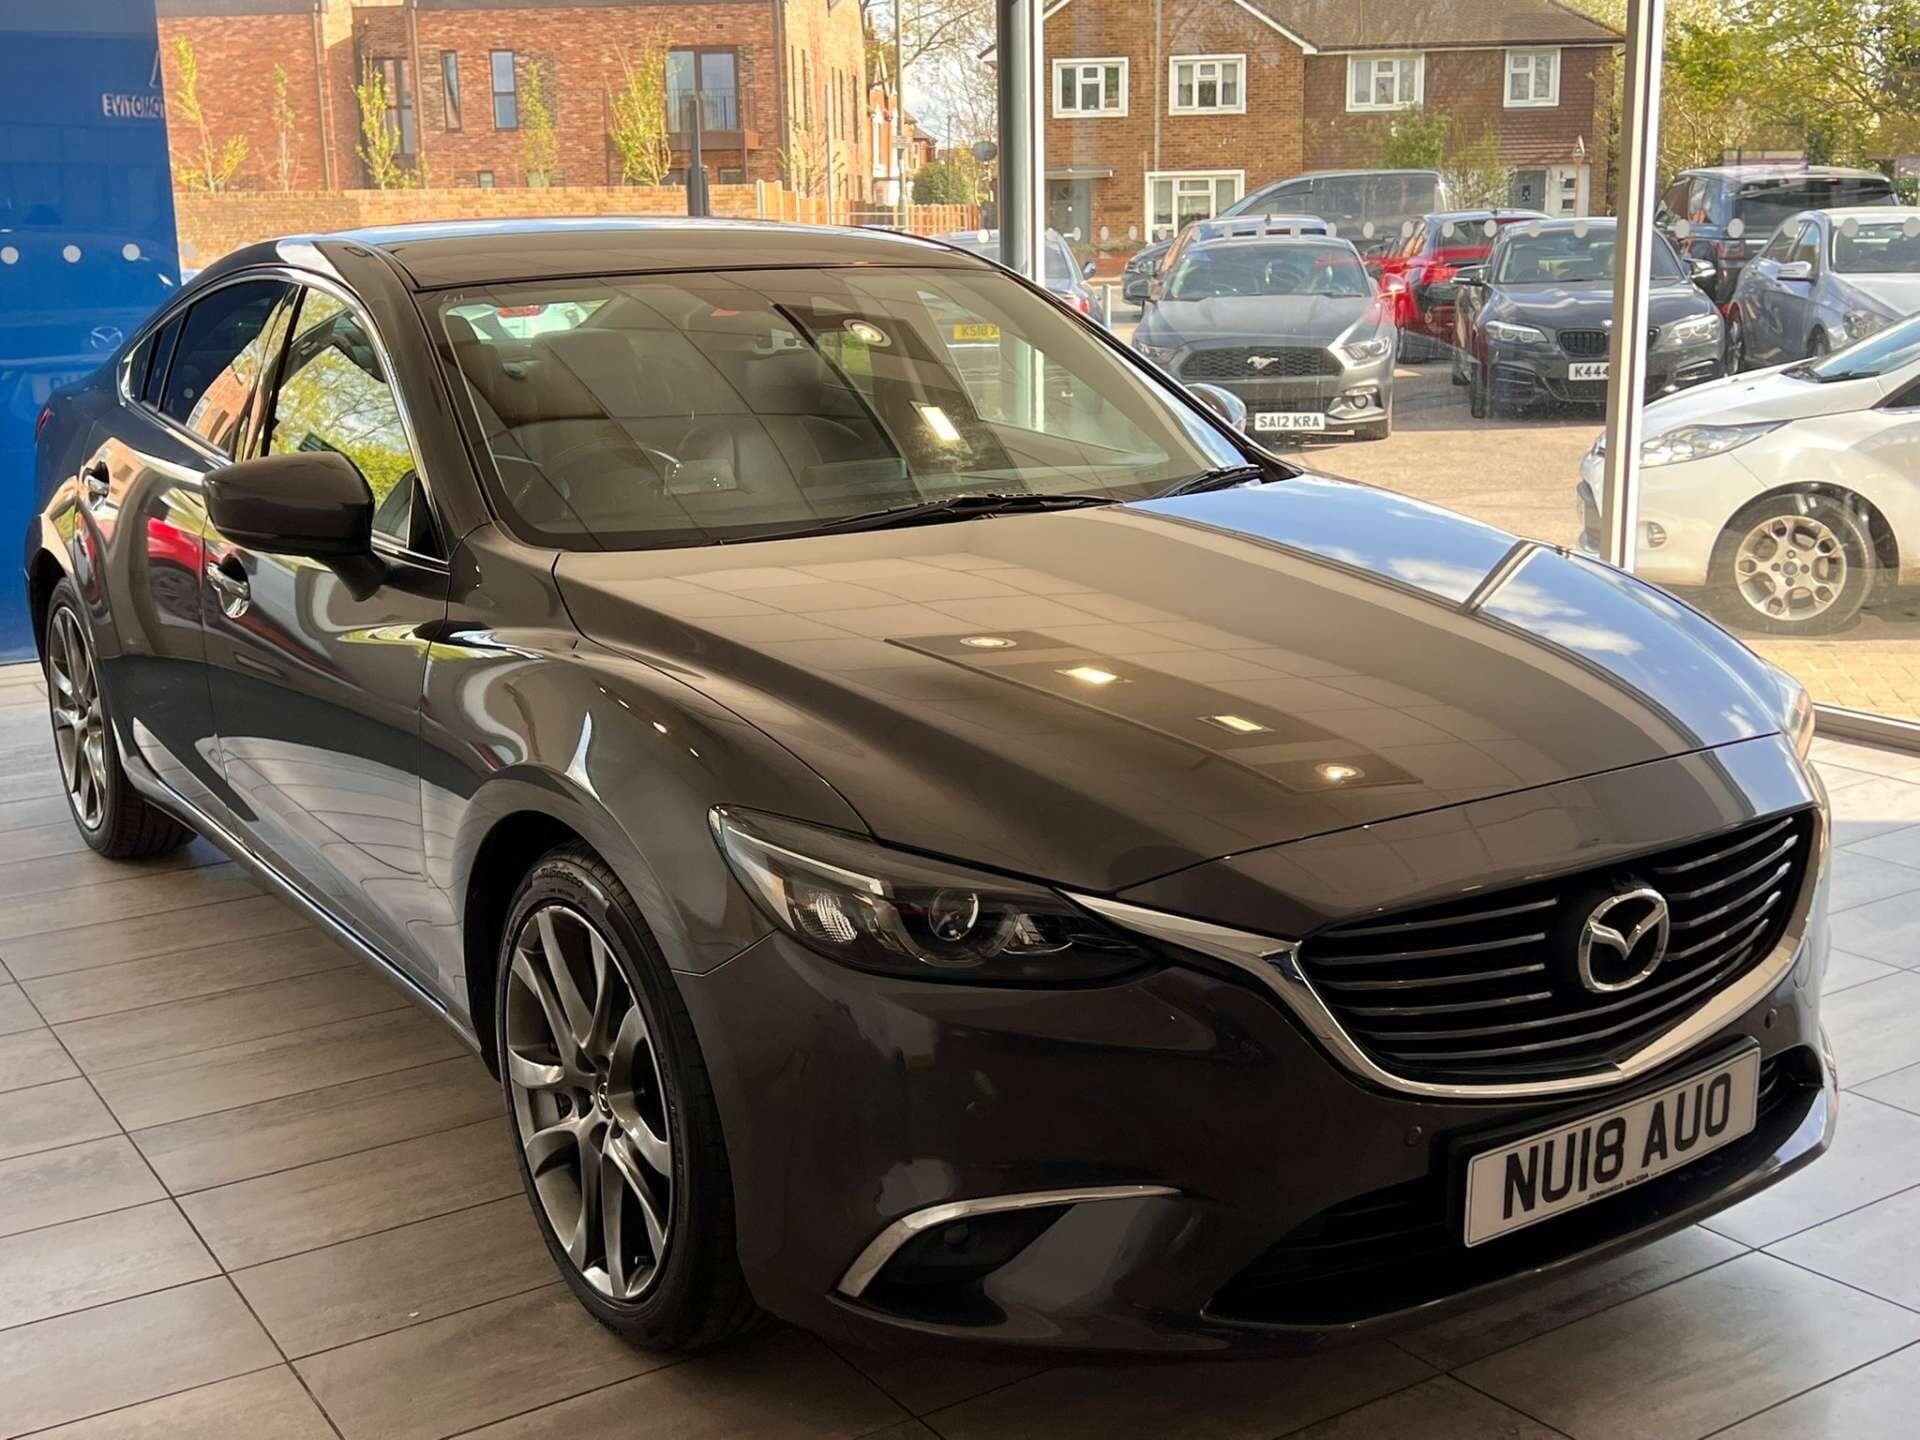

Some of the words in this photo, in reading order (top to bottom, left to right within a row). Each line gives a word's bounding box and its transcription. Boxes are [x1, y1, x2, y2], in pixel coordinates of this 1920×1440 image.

[1259, 415, 1289, 428] SA12
[1293, 415, 1320, 428] KRA
[1503, 1117, 1626, 1220] NU18
[1641, 1072, 1731, 1168] AUO
